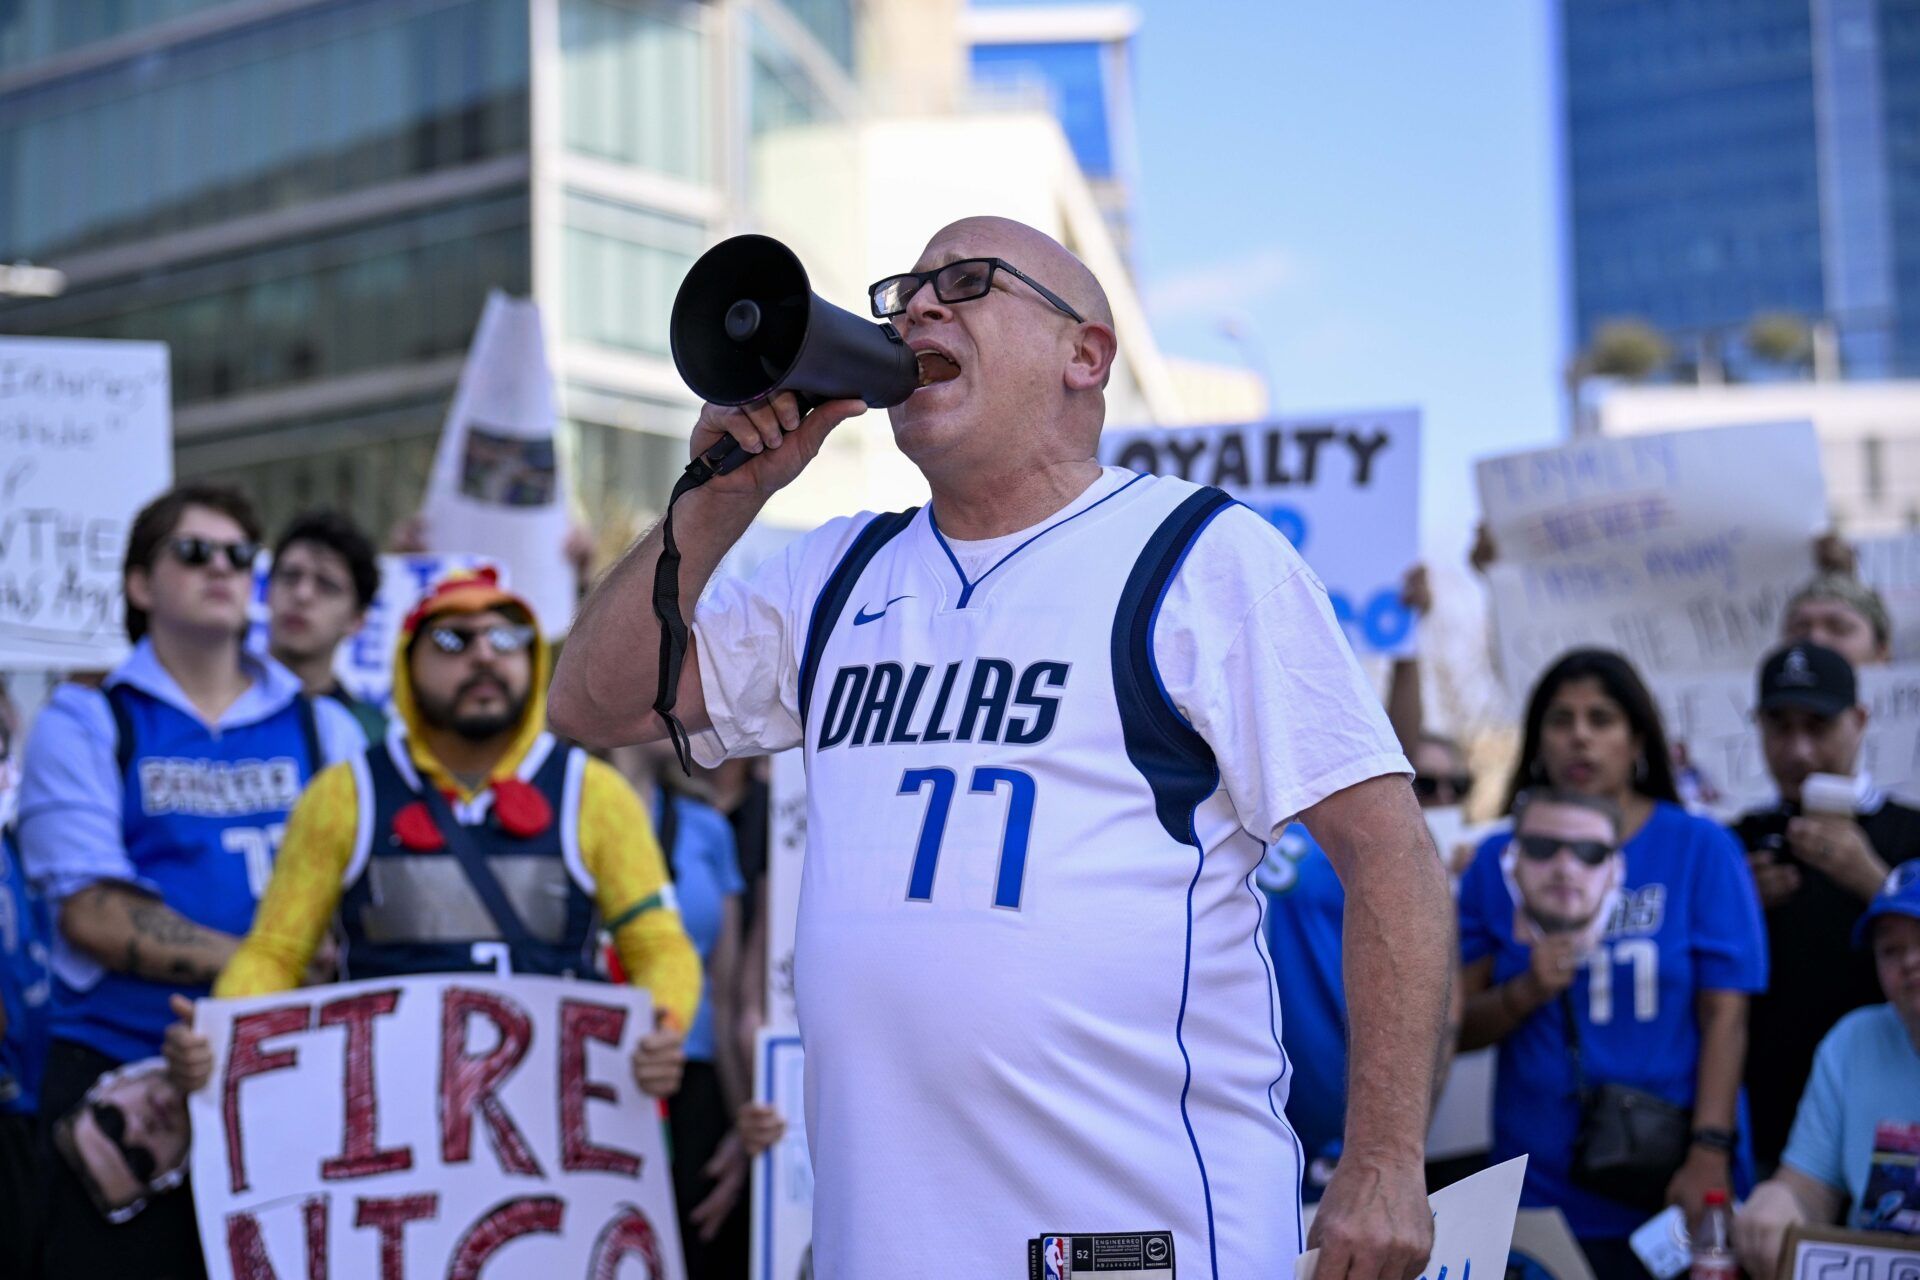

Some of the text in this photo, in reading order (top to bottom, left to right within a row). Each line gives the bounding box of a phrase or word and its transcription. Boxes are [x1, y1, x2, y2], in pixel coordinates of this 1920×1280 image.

[1113, 425, 1392, 488] OYALTY
[817, 656, 1073, 753] DALLAS
[896, 764, 1039, 912] 77
[222, 984, 644, 1194] FIRE
[1076, 1249, 1089, 1259] 52
